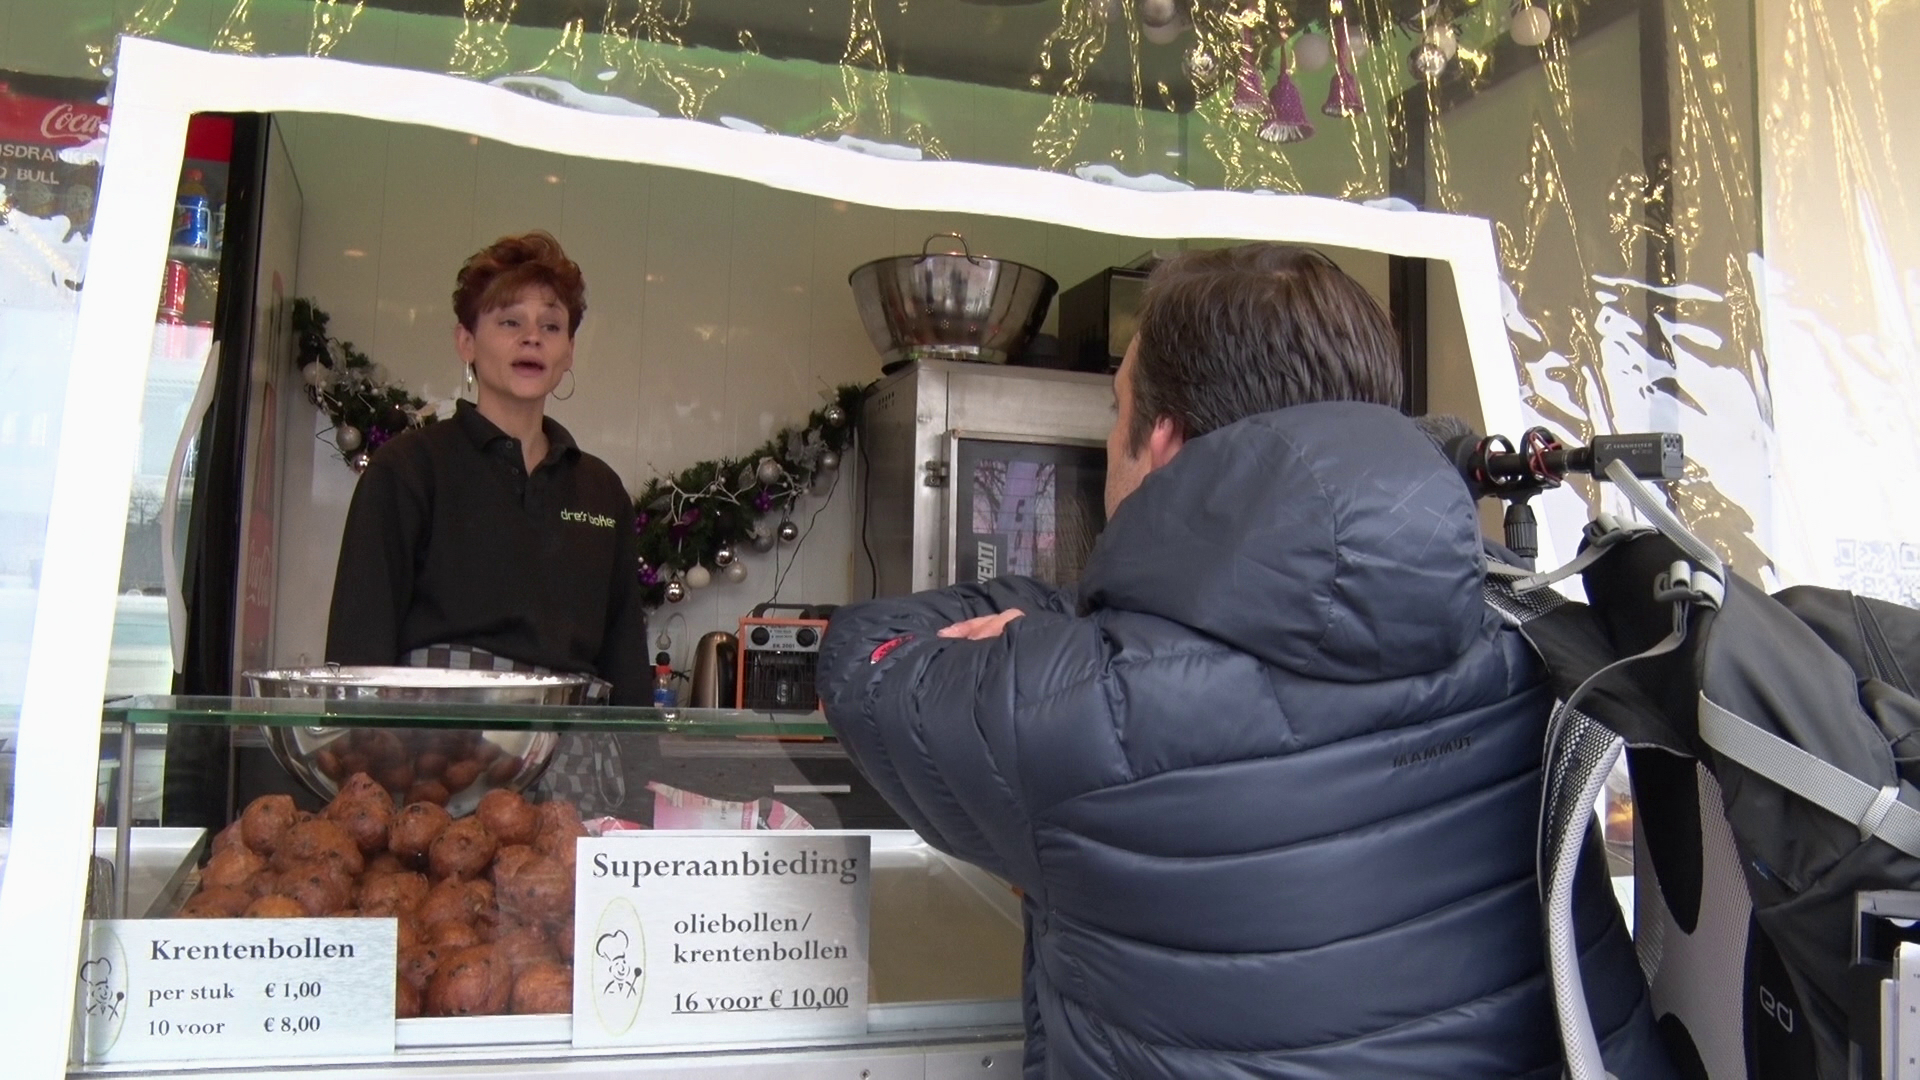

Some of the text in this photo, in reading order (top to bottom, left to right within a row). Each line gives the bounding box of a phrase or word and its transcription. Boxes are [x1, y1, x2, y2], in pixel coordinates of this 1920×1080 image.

[17, 168, 60, 185] BULL
[560, 508, 587, 523] dre's
[1393, 736, 1471, 768] MAMMUT
[593, 851, 858, 888] Superaanbieding
[674, 912, 812, 934] oliebollen/
[150, 937, 355, 960] Krentenbollen
[673, 940, 848, 964] krentenbollen
[148, 981, 322, 1007] per stuk € 1,00
[673, 987, 849, 1012] 16 voor € 10,00
[148, 1016, 321, 1036] 10 voor € 8,00
